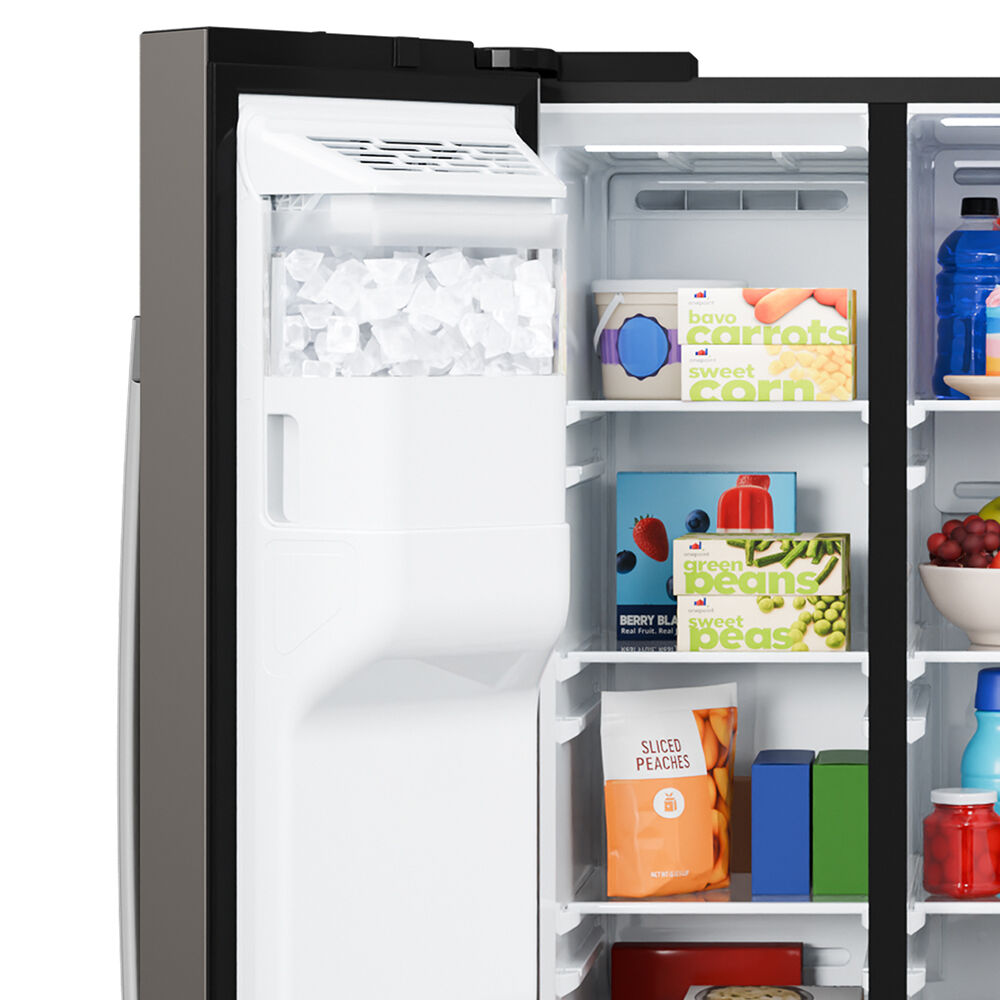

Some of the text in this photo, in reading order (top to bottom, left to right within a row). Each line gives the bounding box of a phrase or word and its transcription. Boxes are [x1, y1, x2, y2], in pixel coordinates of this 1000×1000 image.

[689, 309, 737, 324] bavo
[686, 319, 848, 345] carrots
[689, 363, 755, 379] sweet
[688, 379, 815, 401] corn
[683, 559, 744, 575] green
[683, 568, 820, 595] beans
[619, 614, 654, 626] BERRY
[688, 615, 744, 629] sweet
[620, 627, 674, 635] Real Fruit. Real
[688, 625, 794, 652] peas
[641, 738, 682, 754] SLICED
[635, 754, 691, 772] PEACHES
